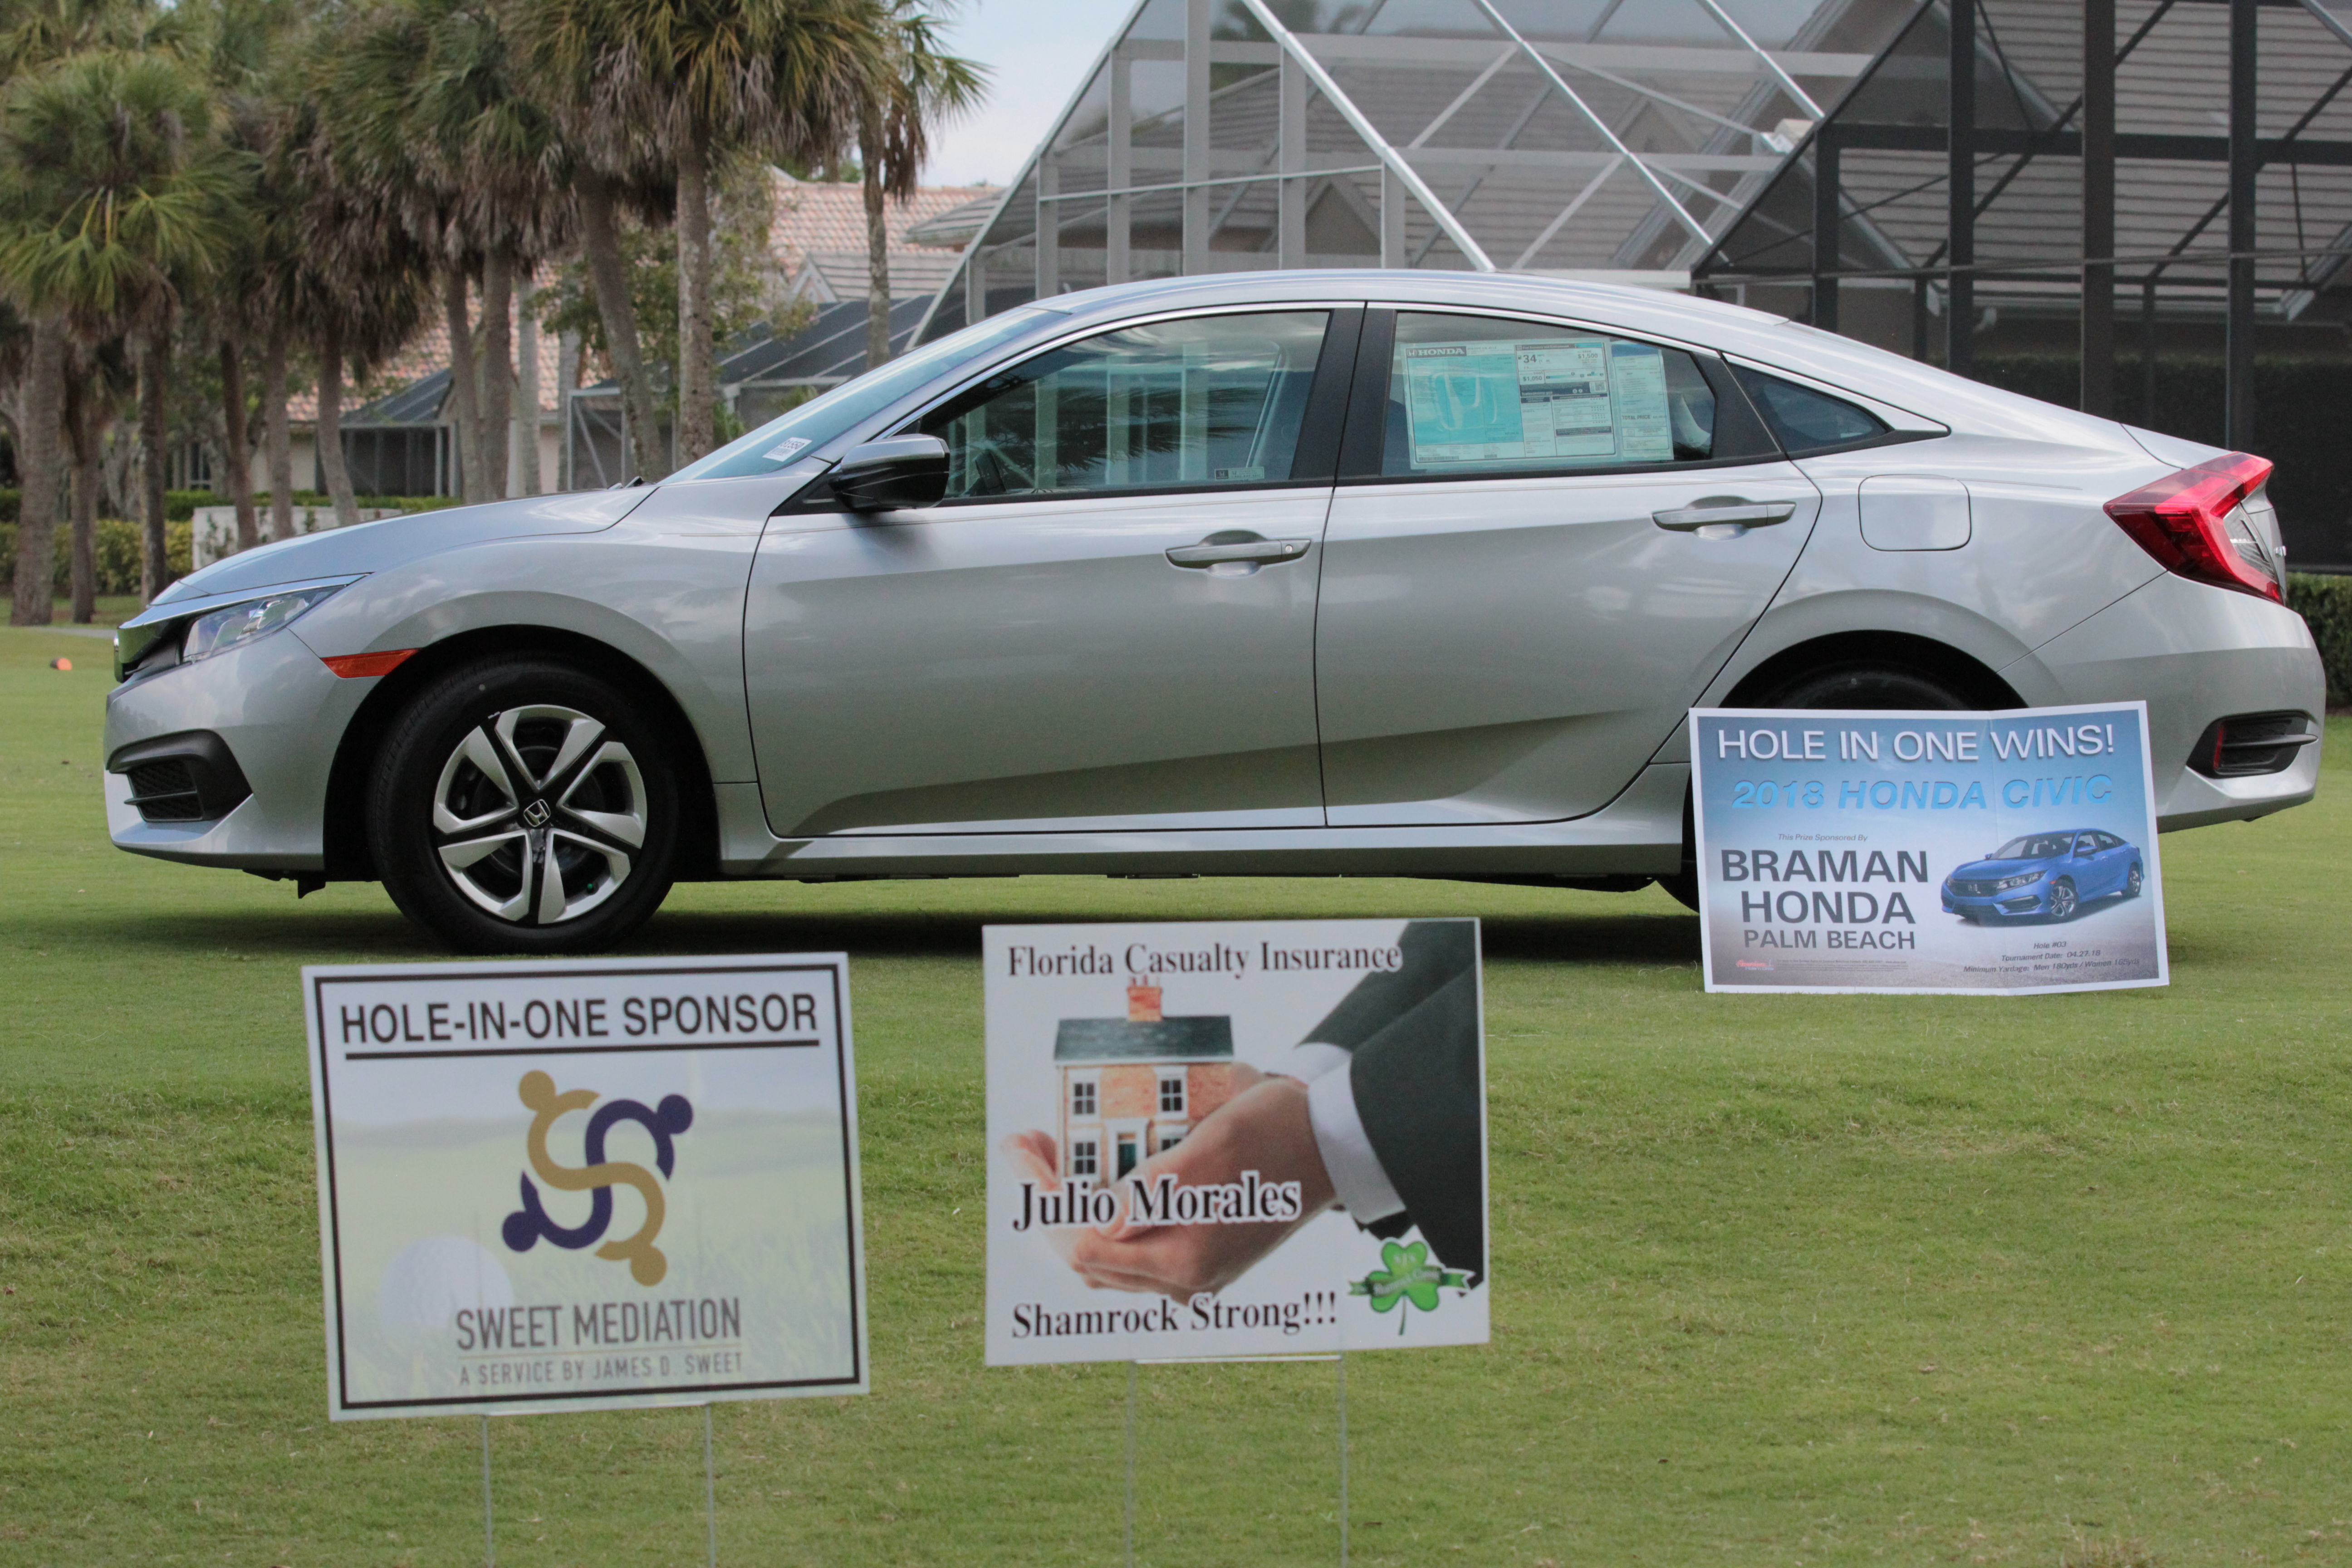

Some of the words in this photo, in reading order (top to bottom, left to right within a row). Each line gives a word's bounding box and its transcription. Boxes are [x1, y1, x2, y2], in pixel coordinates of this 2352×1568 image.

[1418, 348, 1465, 356] HONDA
[1523, 354, 1537, 363] 34
[1718, 730, 1826, 760] HOLE
[1840, 731, 1878, 760] IN
[1894, 731, 1979, 761] ONE
[1990, 724, 2114, 759] WINS!
[1732, 779, 1824, 808] 2018
[1838, 780, 1987, 809] HONDA
[2002, 774, 2112, 808] CIVIC
[1814, 834, 1856, 842] Sponsored
[1857, 834, 1868, 843] By
[1721, 849, 1928, 882] BRAMAN
[1741, 891, 1916, 924] HONDA
[1744, 930, 1817, 948] PALM
[1827, 931, 1915, 949] BEACH
[1008, 944, 1113, 976] Florida
[1125, 942, 1250, 978] Casualty
[1261, 942, 1401, 971] Insurance
[1999, 965, 2030, 974] Yardage:
[2052, 962, 2078, 971] 180yds
[2114, 958, 2140, 967] 165yds
[341, 999, 609, 1044] HOLE-IN-ONE
[624, 993, 818, 1037] SPONSOR
[1012, 1181, 1116, 1231] Julio
[1130, 1175, 1301, 1222] Morales
[456, 1305, 563, 1351] SWEET
[573, 1297, 741, 1346] MEDIATION
[1012, 1303, 1178, 1338] Shamrock
[1191, 1292, 1337, 1334] Strong!!!
[460, 1367, 470, 1385] A
[479, 1362, 555, 1384] SERVICE
[563, 1360, 584, 1381] BY
[594, 1357, 652, 1380] JAMES
[659, 1356, 678, 1377] D.
[686, 1352, 743, 1375] SWEET
